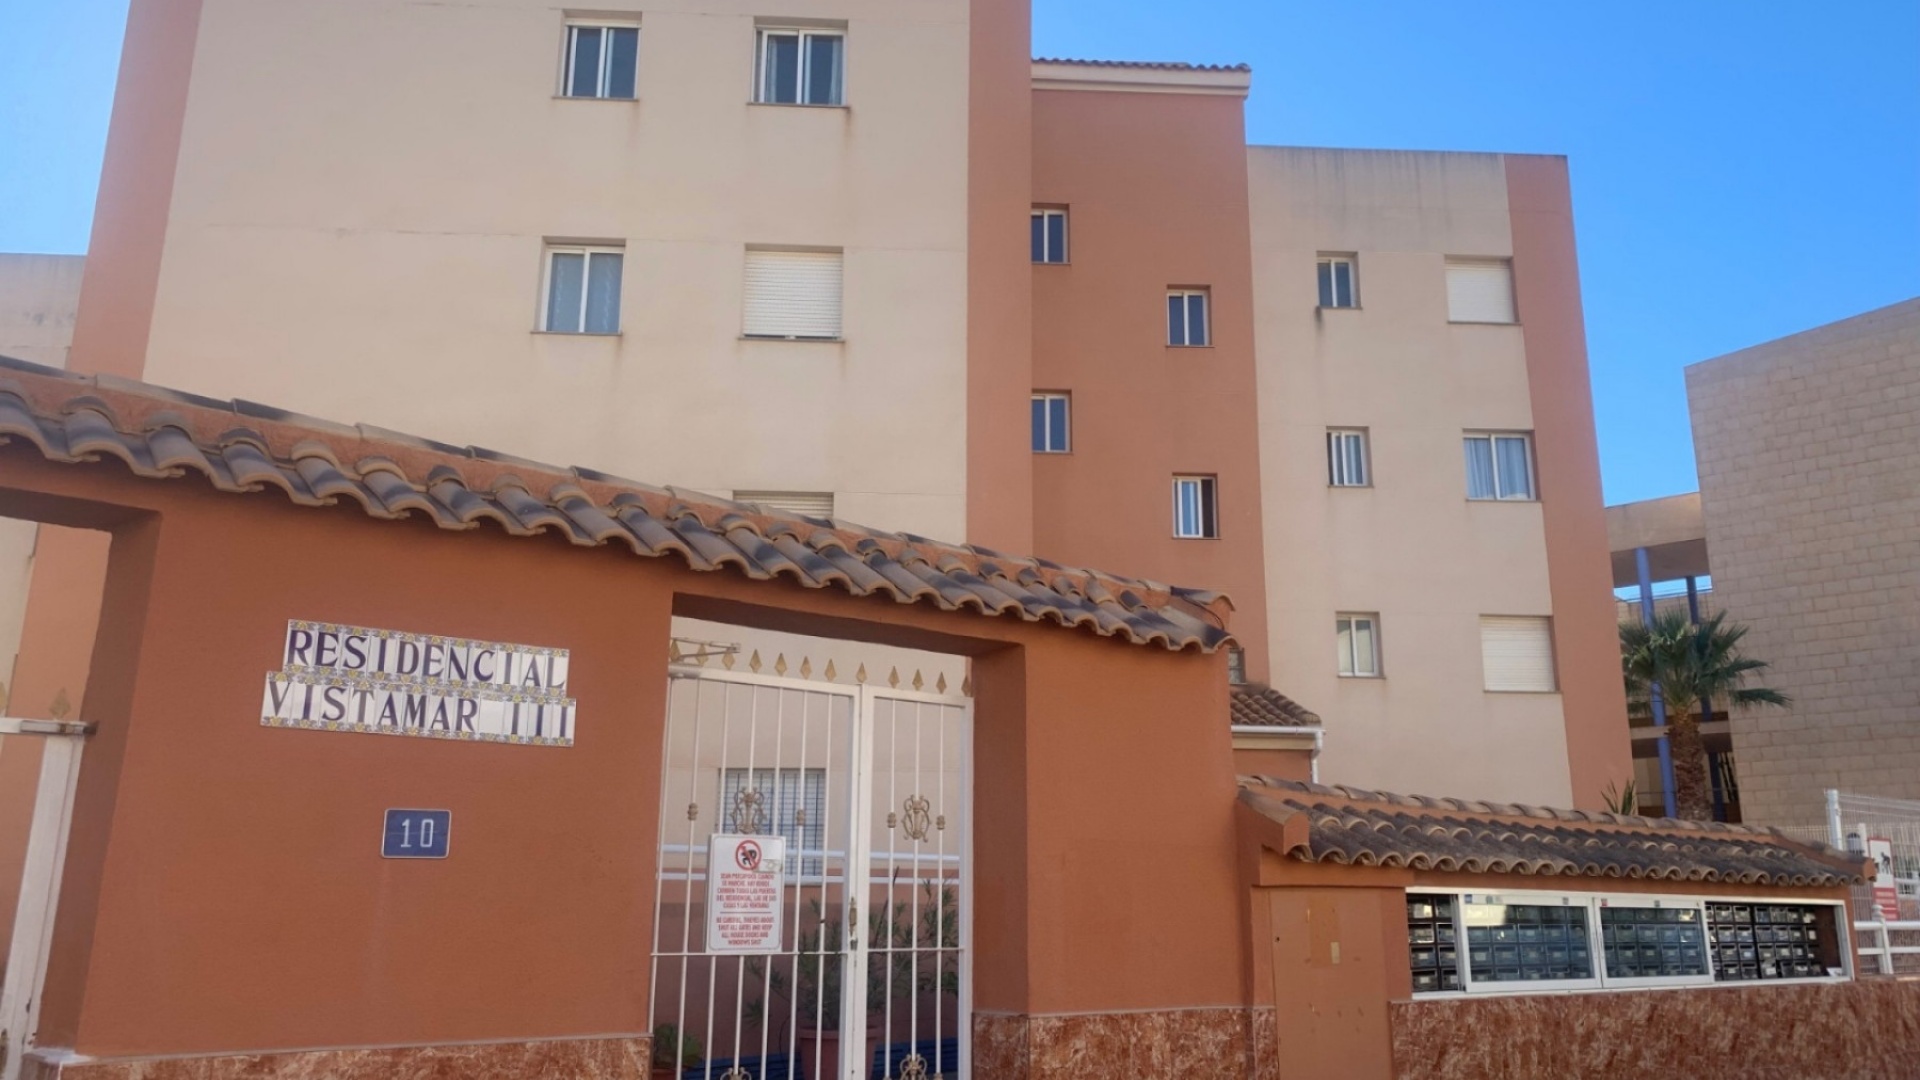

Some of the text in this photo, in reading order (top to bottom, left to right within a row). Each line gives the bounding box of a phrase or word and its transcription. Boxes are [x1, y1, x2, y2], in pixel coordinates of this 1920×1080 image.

[286, 629, 566, 690] RESIDENCIAL
[268, 680, 569, 738] VISTAMAR III
[400, 818, 434, 848] 10
